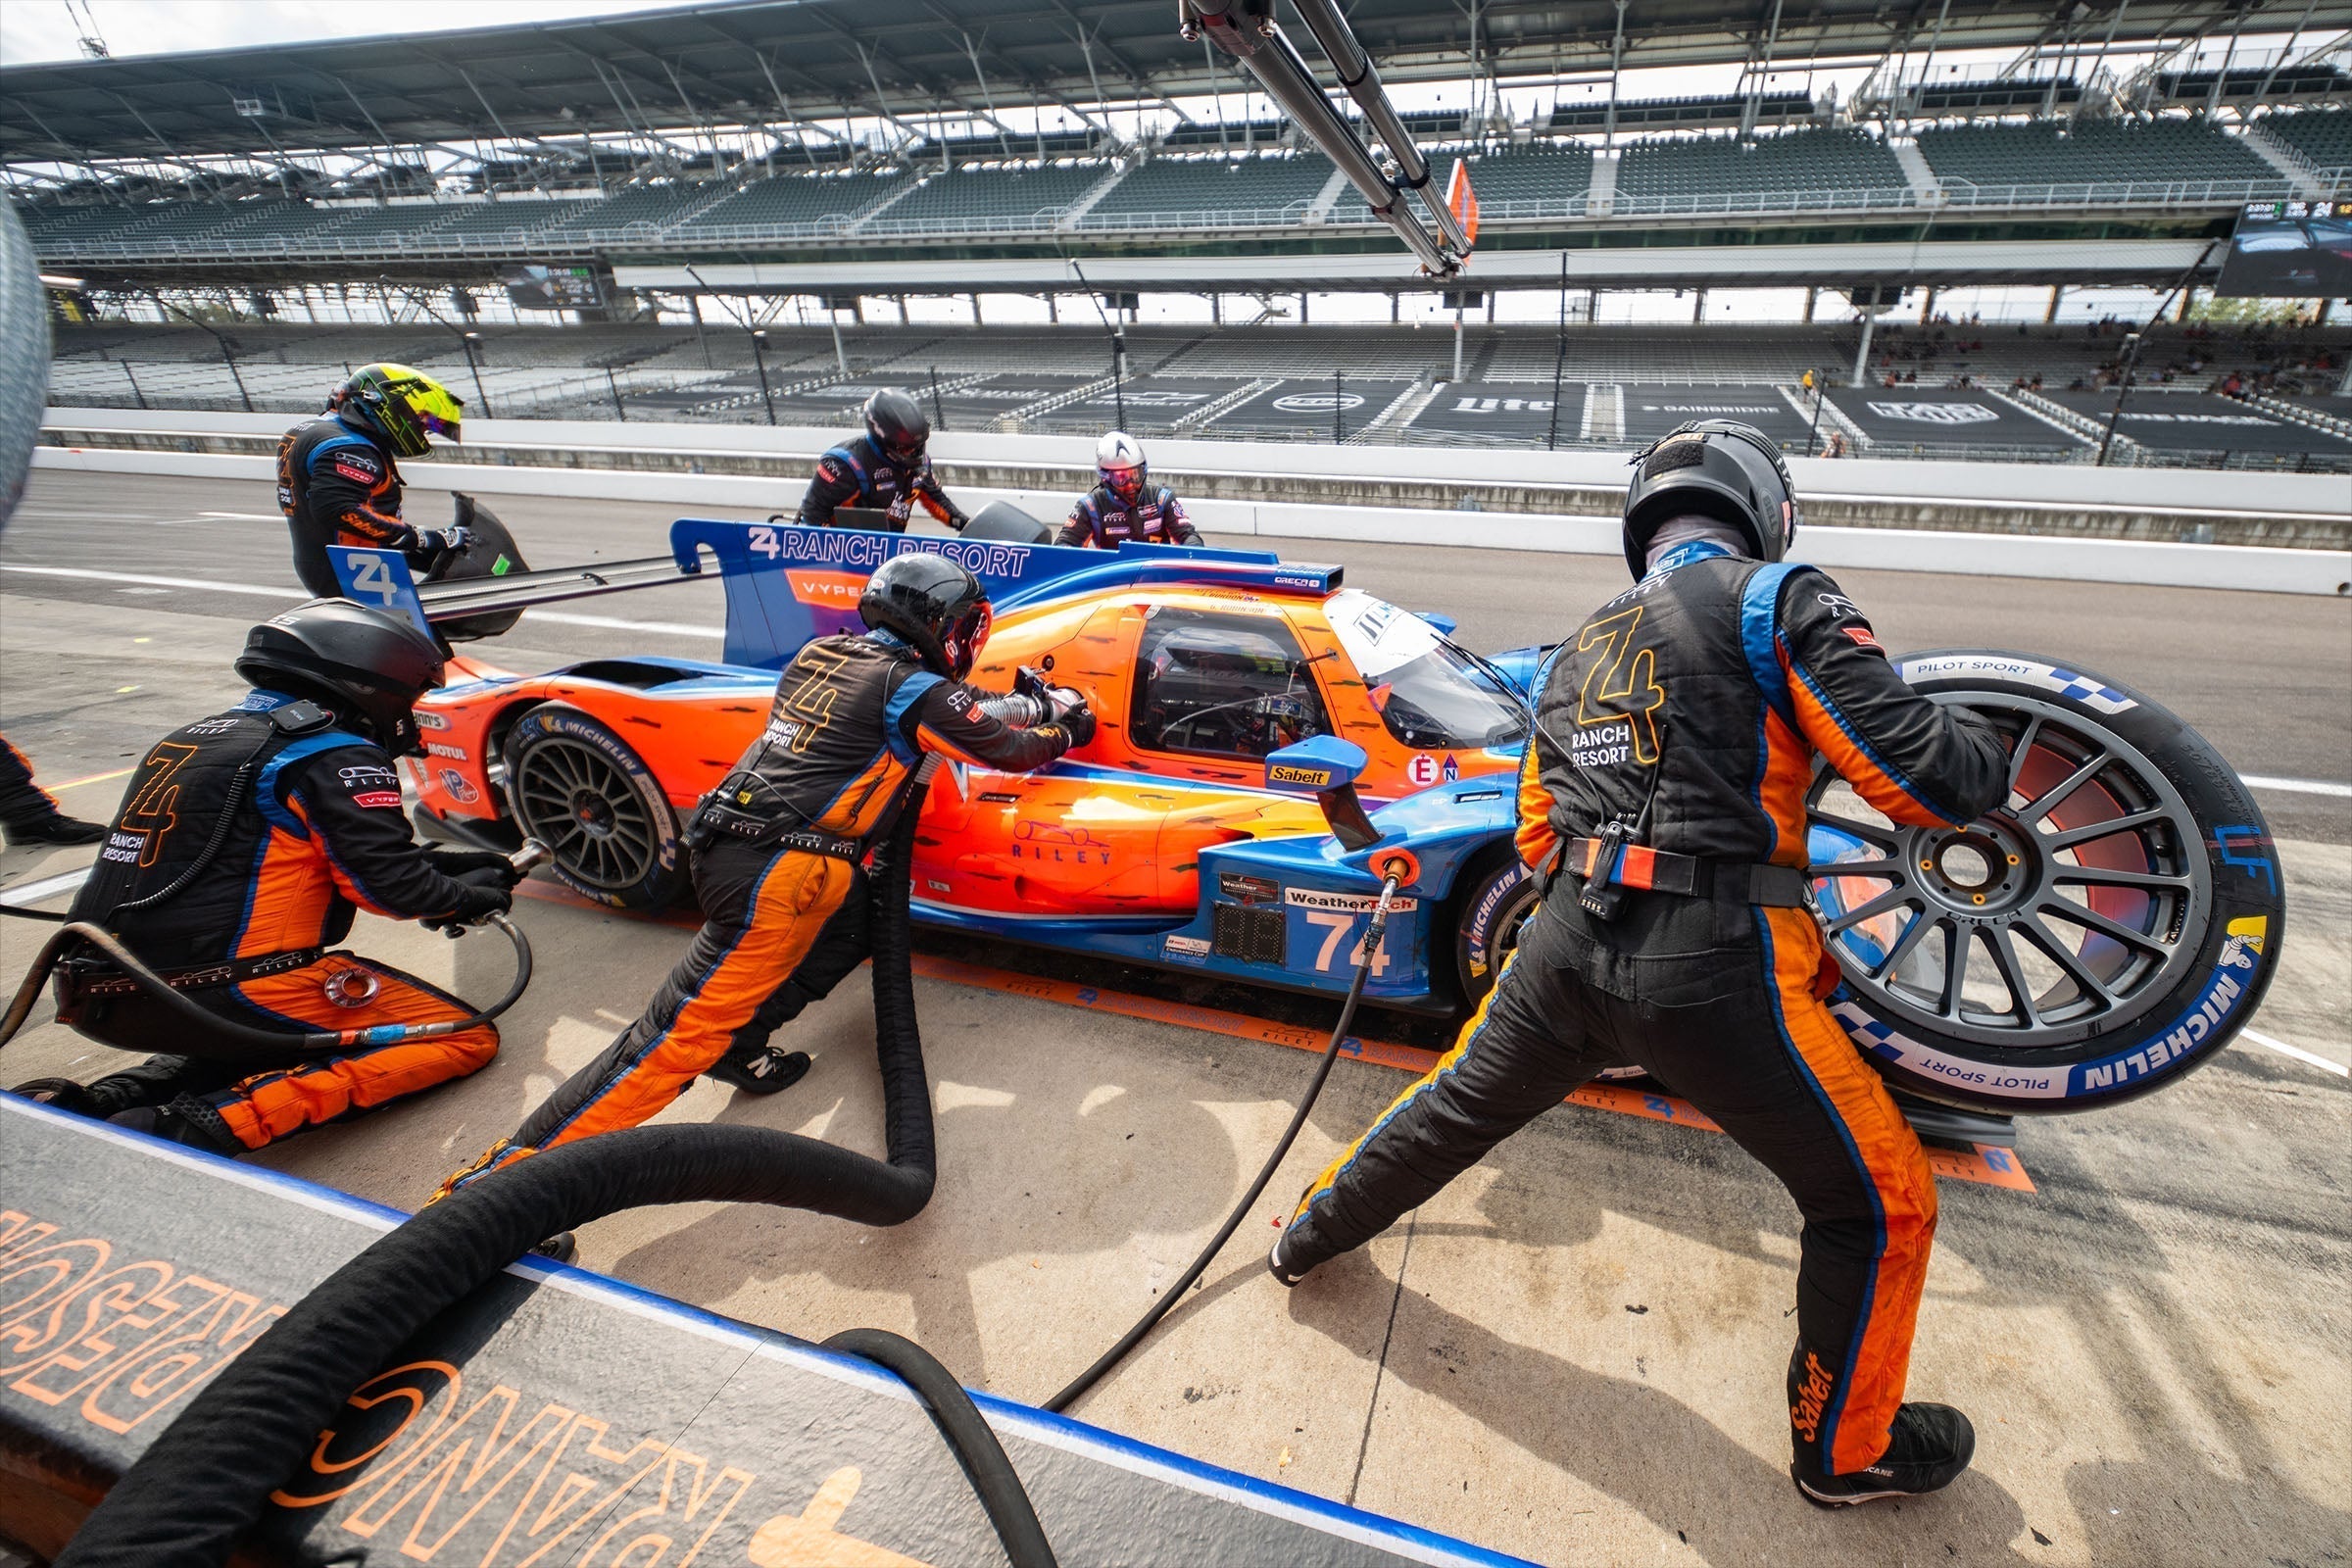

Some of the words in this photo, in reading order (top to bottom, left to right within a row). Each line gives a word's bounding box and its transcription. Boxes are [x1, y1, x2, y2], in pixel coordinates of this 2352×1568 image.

[1449, 397, 1552, 414] Lite
[1663, 405, 1780, 415] GAINBRIDGE
[1763, 493, 1779, 530] BELL
[748, 526, 781, 561] 74
[782, 530, 888, 565] RANCH
[347, 553, 398, 607] 74
[1274, 576, 1308, 586] ORECA
[802, 581, 864, 597] VYPE
[1918, 662, 1965, 673] PILOT
[1971, 662, 2034, 675] SPORT
[1578, 606, 1665, 764] 74
[564, 720, 637, 770] MICHELIN
[1572, 724, 1630, 749] RANCH
[427, 742, 467, 760] MOTUL
[1573, 746, 1629, 767] RESORT
[1274, 766, 1325, 784] Sabelt
[121, 742, 198, 868] 74
[731, 824, 760, 836] RILE
[110, 833, 145, 850] RANCH
[780, 837, 820, 850] RILEY
[101, 847, 139, 863] RESORT
[1011, 844, 1110, 865] RILEY
[1290, 892, 1414, 909] WeatherTch
[1472, 870, 1516, 948] MICHELIN
[1306, 911, 1391, 977] 74
[252, 957, 303, 974] RILEY
[170, 973, 231, 988] RILEY
[90, 985, 136, 994] RILE
[1261, 1031, 1314, 1047] RILEY
[2084, 972, 2241, 1090] MICHELIN
[1919, 1058, 1986, 1084] SPORT
[1990, 1077, 2049, 1090] PILOT
[1571, 1093, 1616, 1106] ILEY
[1936, 1163, 1975, 1177] LEY
[1791, 1352, 1834, 1443] Sabelt
[270, 1359, 755, 1568] RANC
